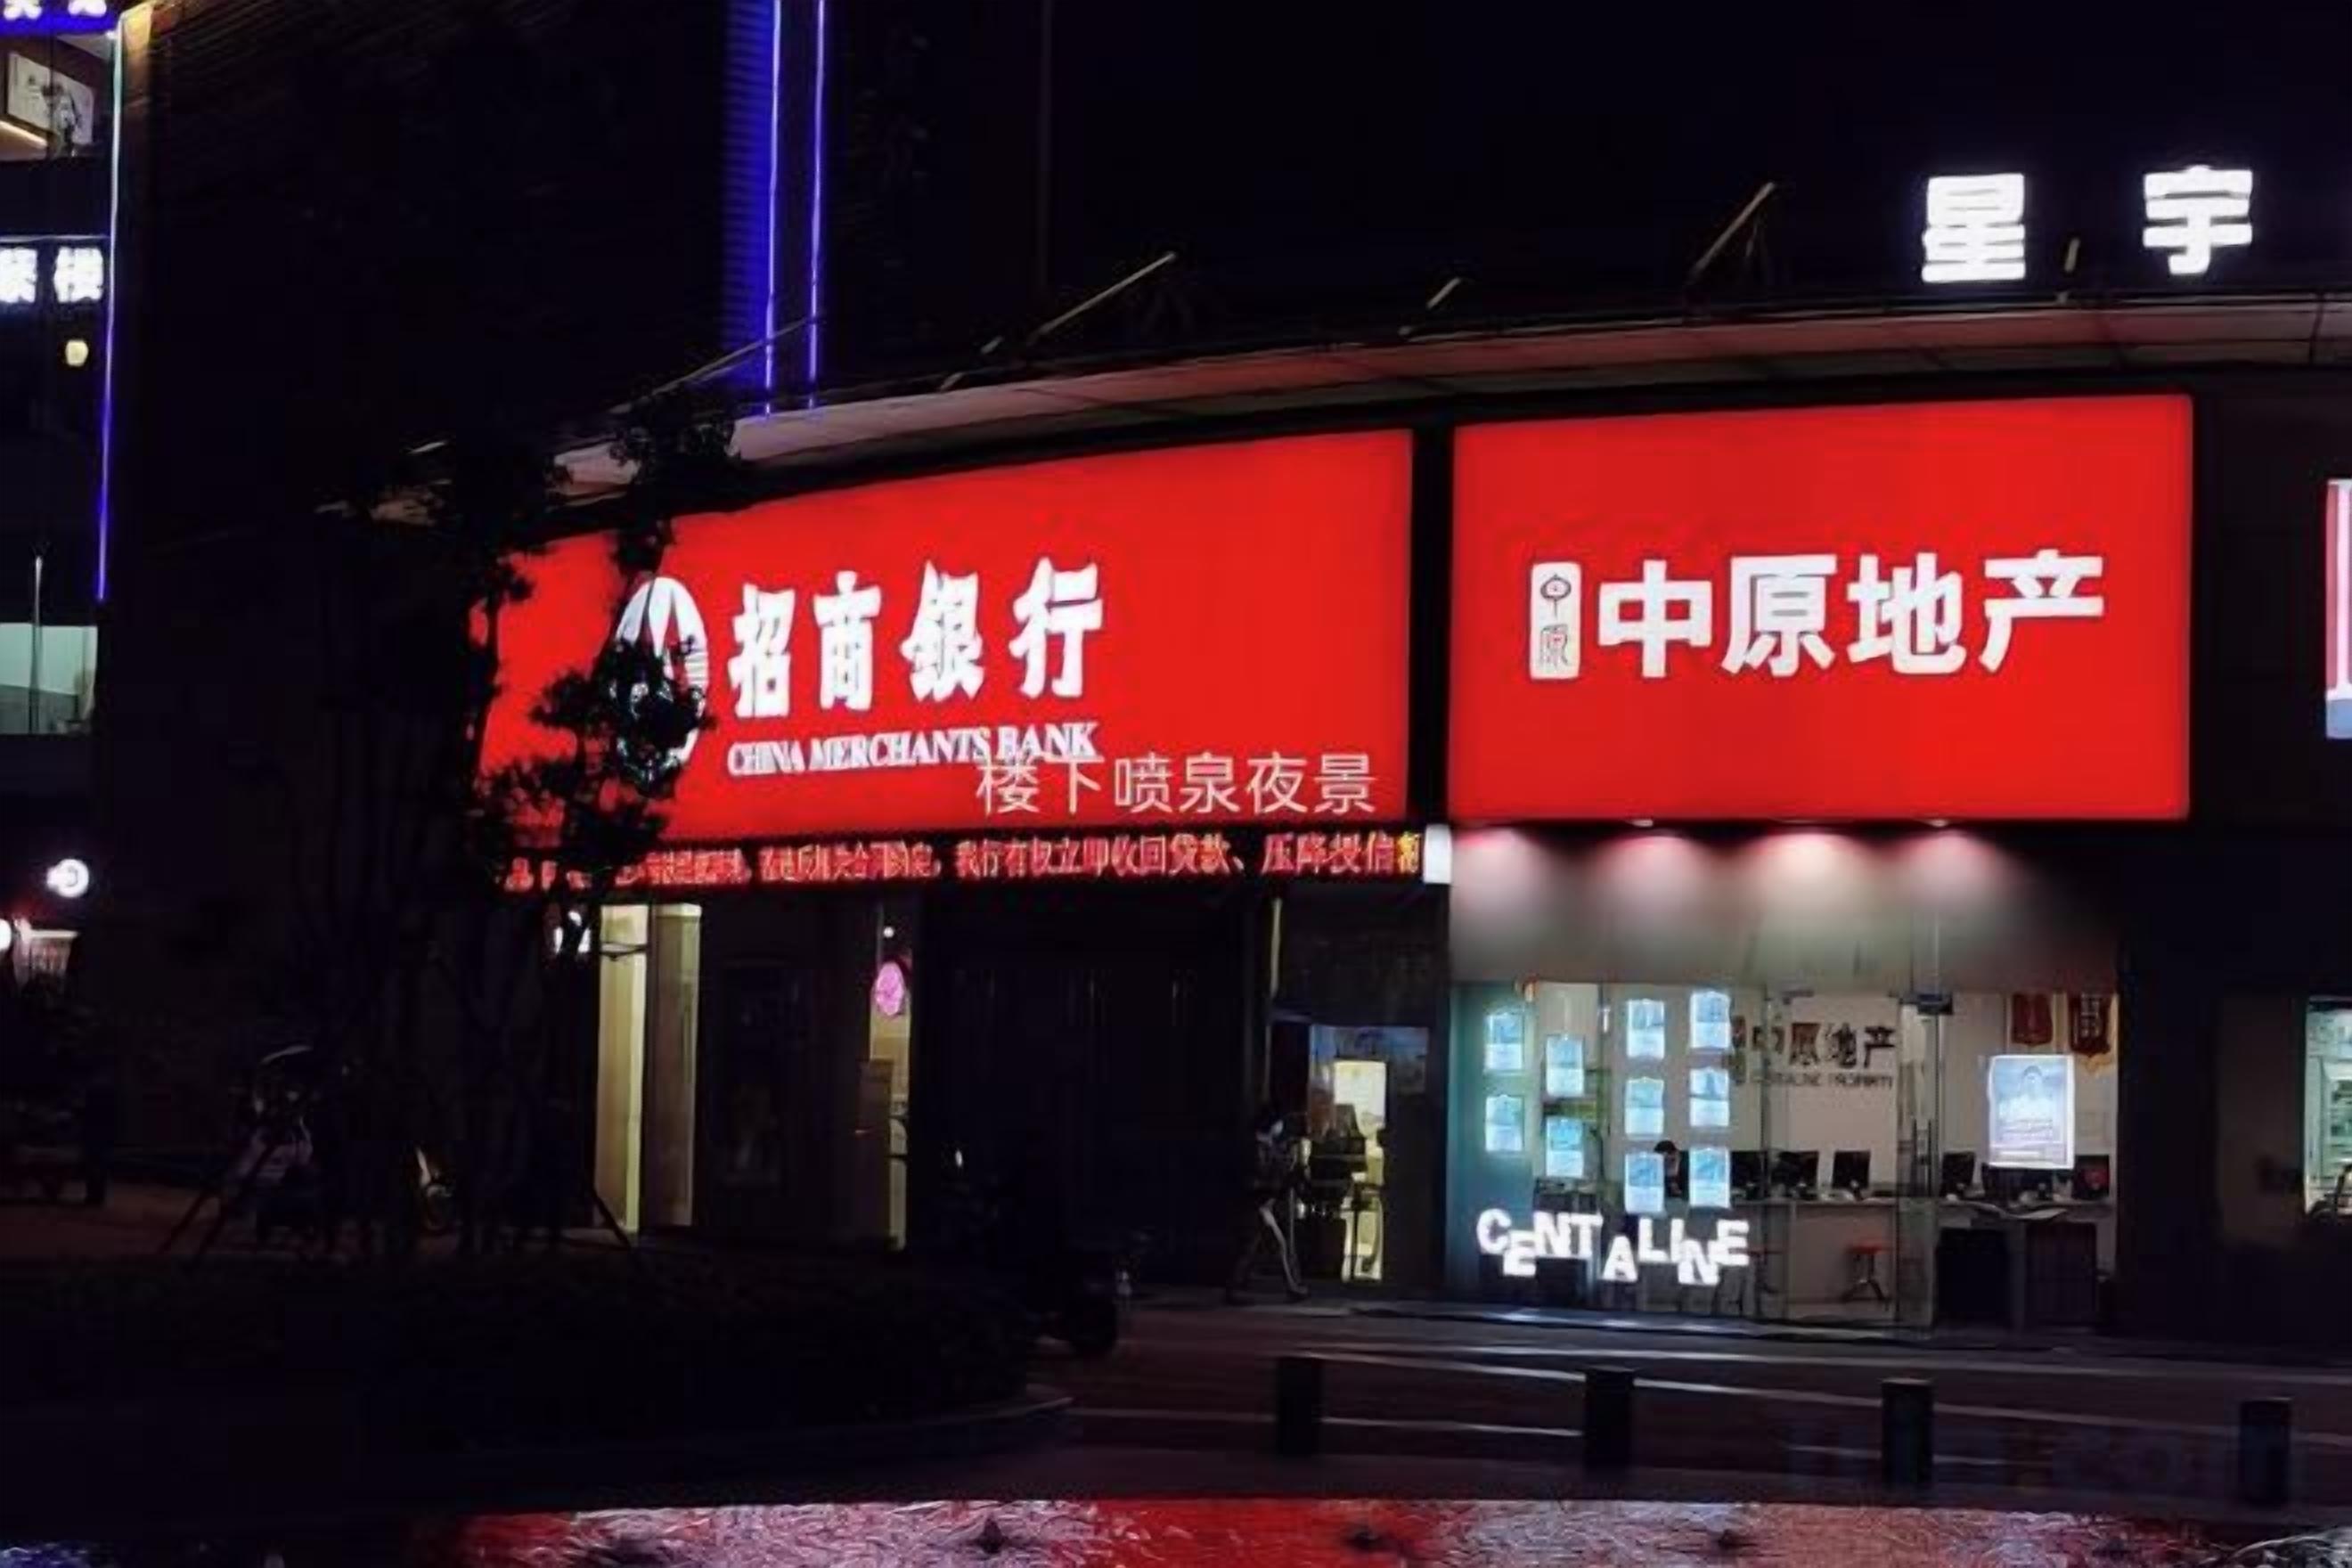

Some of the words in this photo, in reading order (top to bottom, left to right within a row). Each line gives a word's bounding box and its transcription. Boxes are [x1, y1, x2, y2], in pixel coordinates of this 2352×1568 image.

[1922, 165, 2253, 283] 星宇
[727, 557, 1103, 718] 招商银行
[1598, 549, 2103, 678] 中原地产
[727, 739, 807, 777] CHINA
[807, 727, 992, 772] MERCHANTS
[995, 722, 1099, 758] BANK
[1476, 1207, 1750, 1286] CENTALINE
